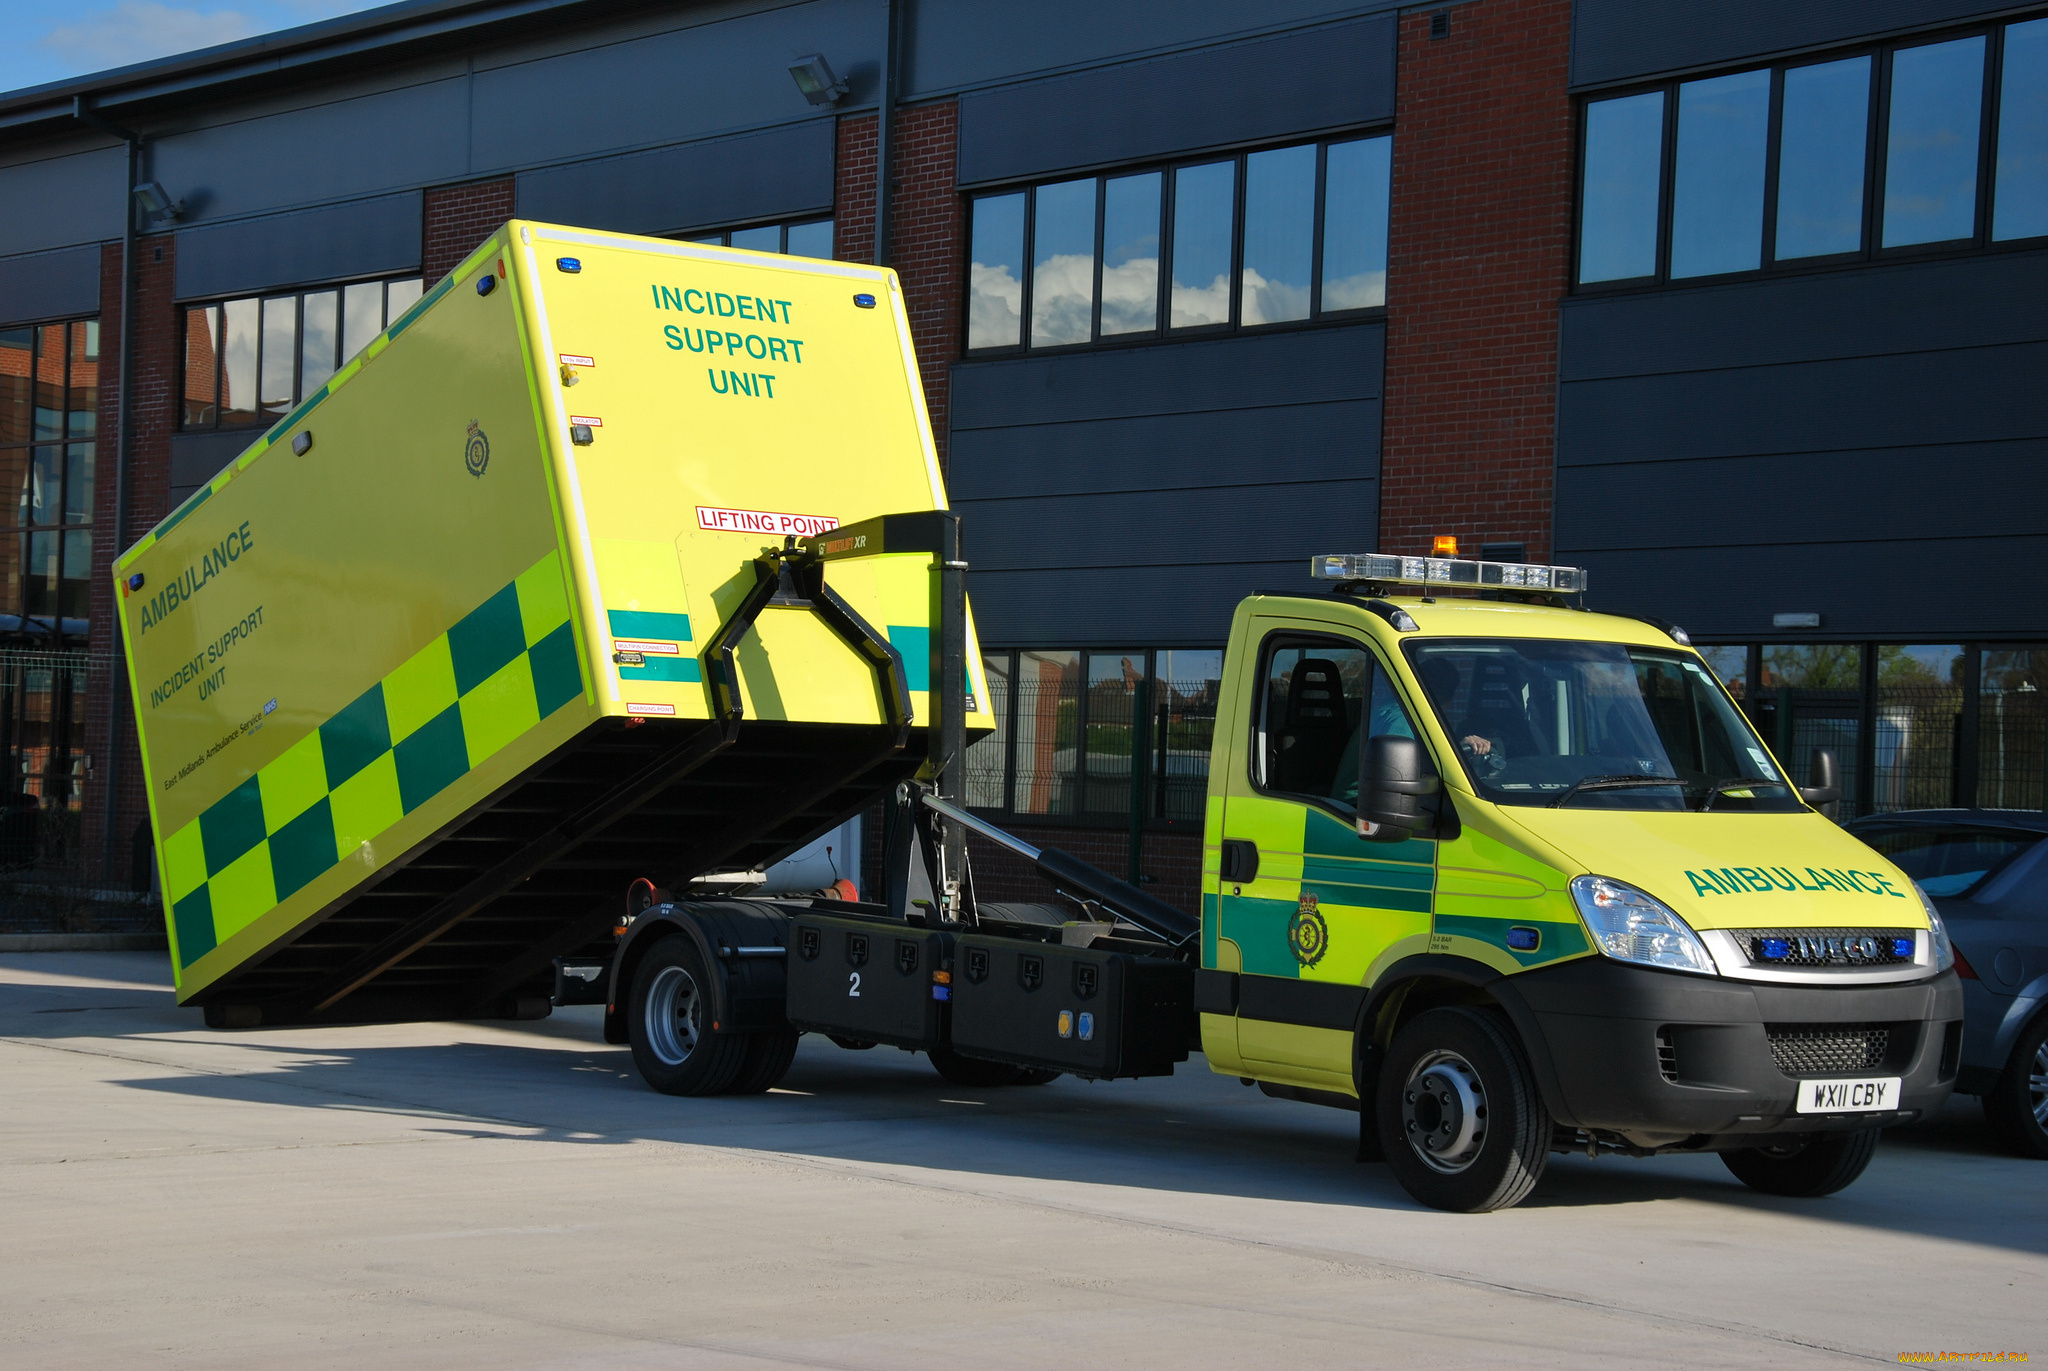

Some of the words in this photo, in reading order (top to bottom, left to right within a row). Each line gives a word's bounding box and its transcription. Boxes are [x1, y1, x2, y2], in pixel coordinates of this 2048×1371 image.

[651, 284, 792, 324] INCIDENT
[663, 325, 804, 364] SUPPORT
[708, 368, 776, 399] UNIT
[700, 510, 775, 531] LIFTING
[780, 516, 837, 535] POINT
[854, 535, 866, 549] XR
[140, 520, 254, 635] AMBULANCE
[150, 652, 204, 709] INCIDENT
[207, 605, 264, 664] SUPPORT
[198, 666, 226, 701] UNIT
[164, 775, 178, 790] East
[178, 754, 205, 780] Midlands
[206, 730, 239, 760] Ambulance
[239, 712, 262, 734] Service
[264, 698, 277, 715] NHS
[1684, 866, 1906, 898] AMBULANCE
[1797, 937, 1878, 958] IVECO
[849, 972, 861, 997] 2
[1815, 1084, 1848, 1108] WX11
[1852, 1083, 1887, 1107] CBY
